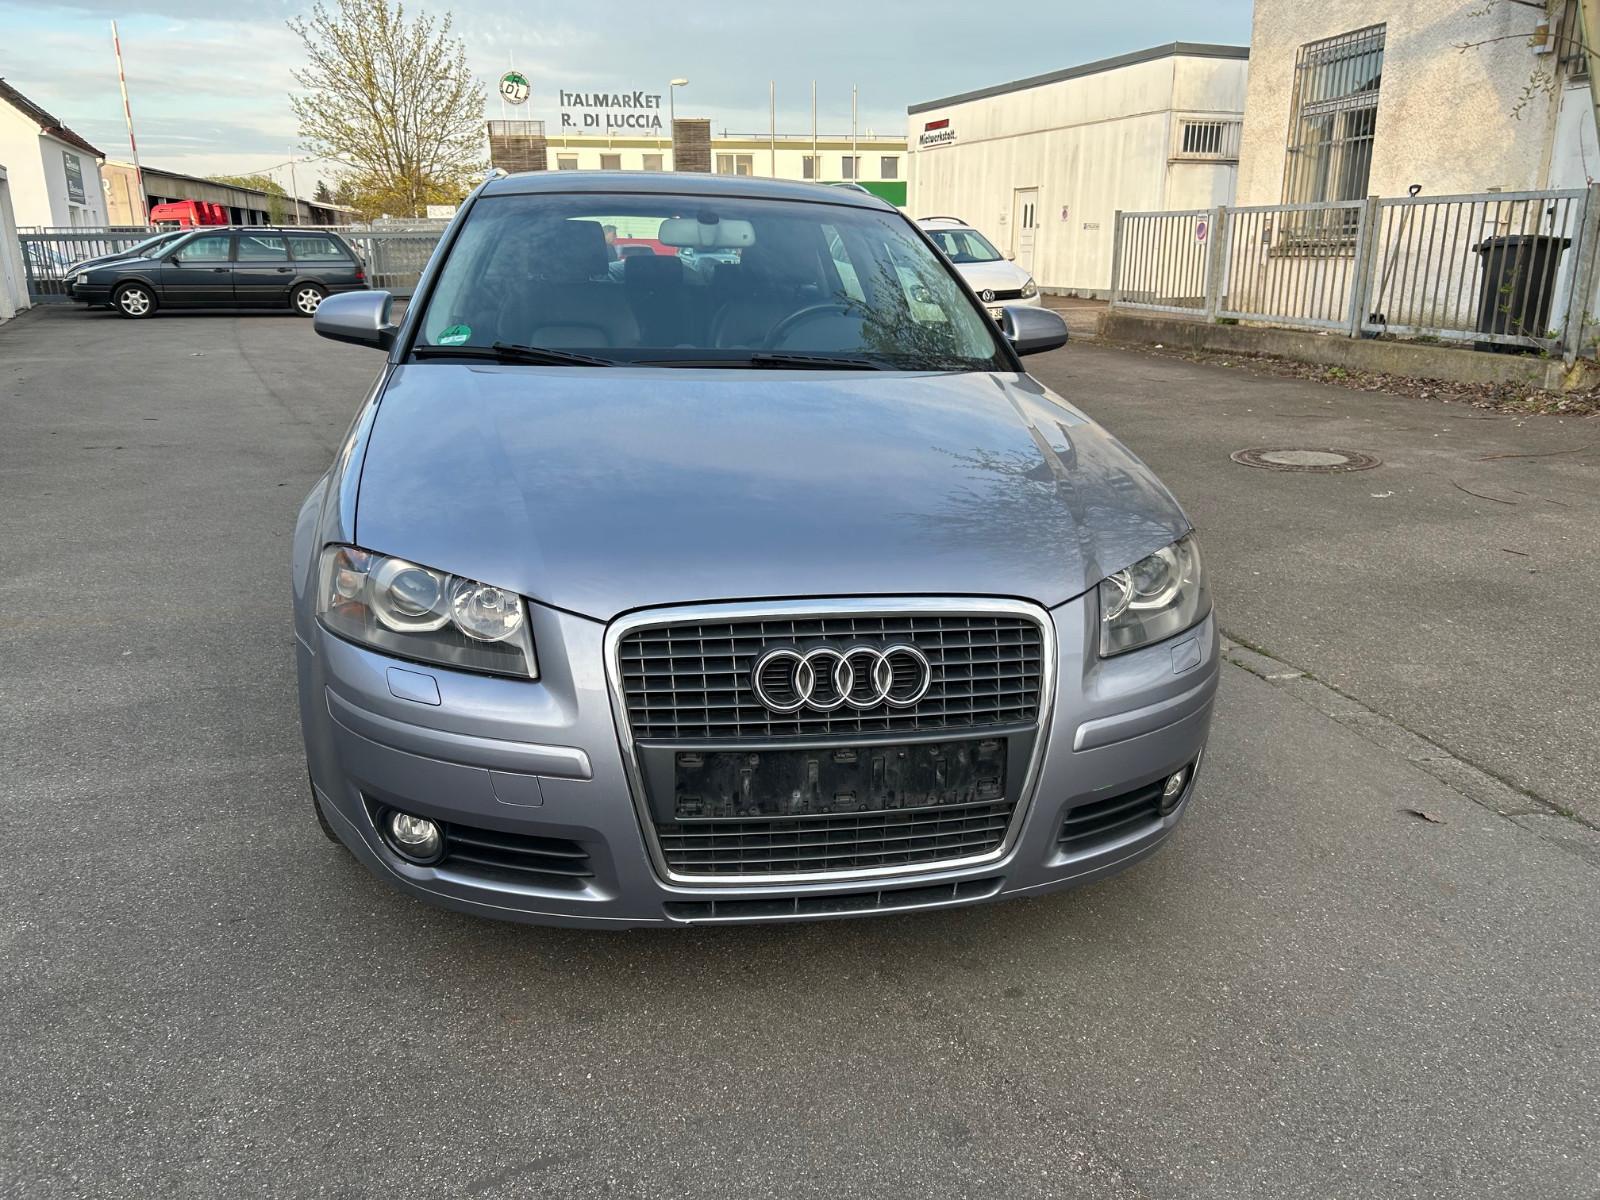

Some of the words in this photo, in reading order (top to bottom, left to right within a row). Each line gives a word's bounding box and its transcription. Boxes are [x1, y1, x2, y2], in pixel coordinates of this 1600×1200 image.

[559, 89, 662, 109] ITALMARKET
[561, 112, 577, 127] R.
[583, 113, 600, 128] DI
[606, 114, 662, 129] LUCCIA
